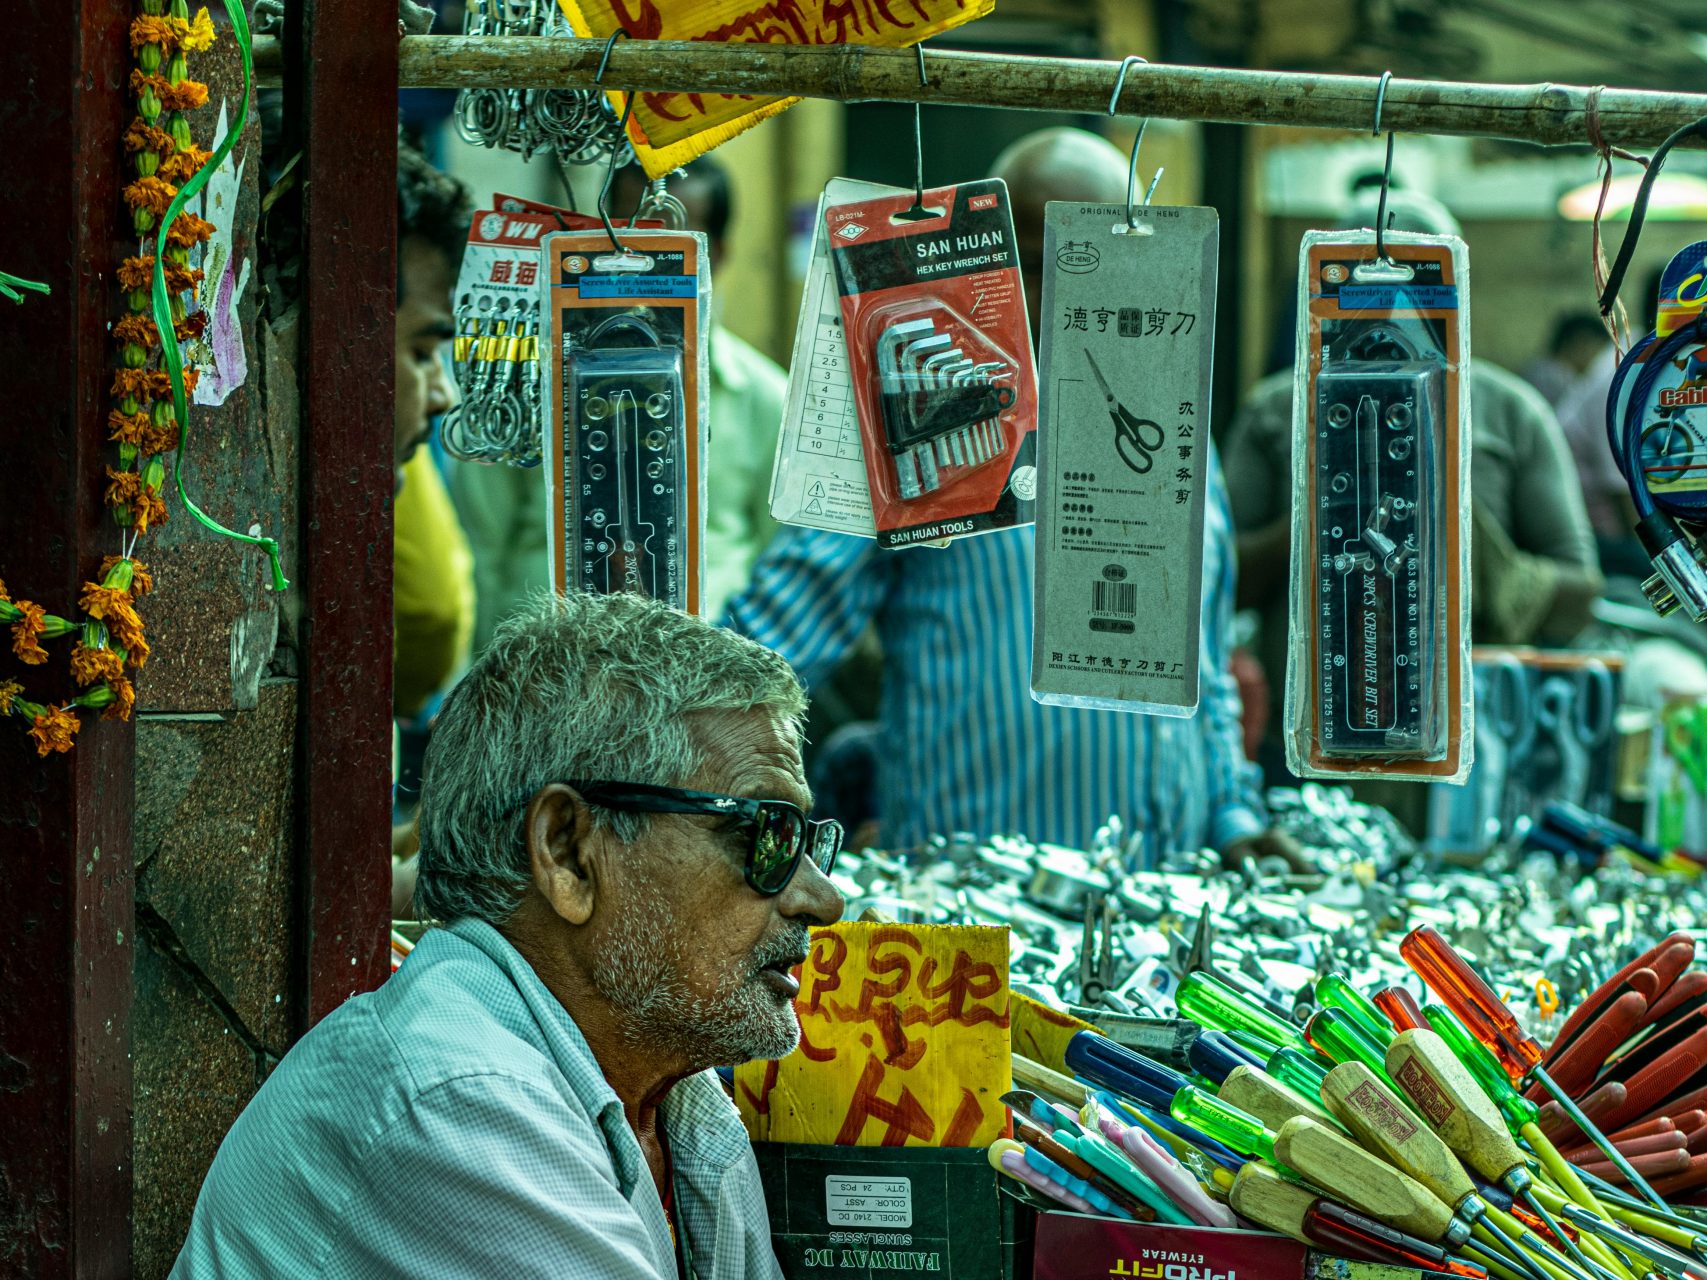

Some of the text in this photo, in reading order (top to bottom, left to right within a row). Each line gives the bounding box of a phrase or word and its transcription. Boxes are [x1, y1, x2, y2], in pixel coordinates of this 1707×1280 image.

[972, 198, 993, 208] NEW
[1080, 208, 1121, 216] ORIGINAL
[1156, 210, 1180, 218] HENG
[916, 230, 1004, 258] SAN HUAN
[916, 252, 1009, 276] HEX KEY WRENCH SET
[672, 278, 692, 286] Tools
[1144, 306, 1196, 336] 剪刀
[828, 330, 842, 339] 1.5
[829, 344, 836, 352] 2
[822, 358, 838, 366] 2.5
[824, 372, 830, 380] 3
[822, 386, 828, 394] 4
[820, 400, 826, 408] 5
[815, 426, 822, 434] 8
[811, 440, 822, 449] 10
[890, 520, 974, 545] SAN HUAN TOOLS
[585, 561, 593, 574] H5
[1408, 558, 1416, 576] NO.3
[1409, 603, 1417, 622] NO.1
[1322, 554, 1333, 739] H6 H5 H4 H3 T40 T30 T25 T20
[1362, 575, 1378, 728] 28PCS SCREWDRIVER BIT SET
[1402, 1062, 1450, 1123] KOHINOOR
[863, 1184, 872, 1192] 24
[876, 1200, 906, 1208] COLOR:
[838, 1212, 852, 1220] DC
[854, 1213, 872, 1222] 2140
[828, 1232, 912, 1246] SUNGLASSES
[804, 1248, 941, 1271] FAIRWAY DC
[1142, 1248, 1204, 1264] EYEWEAR
